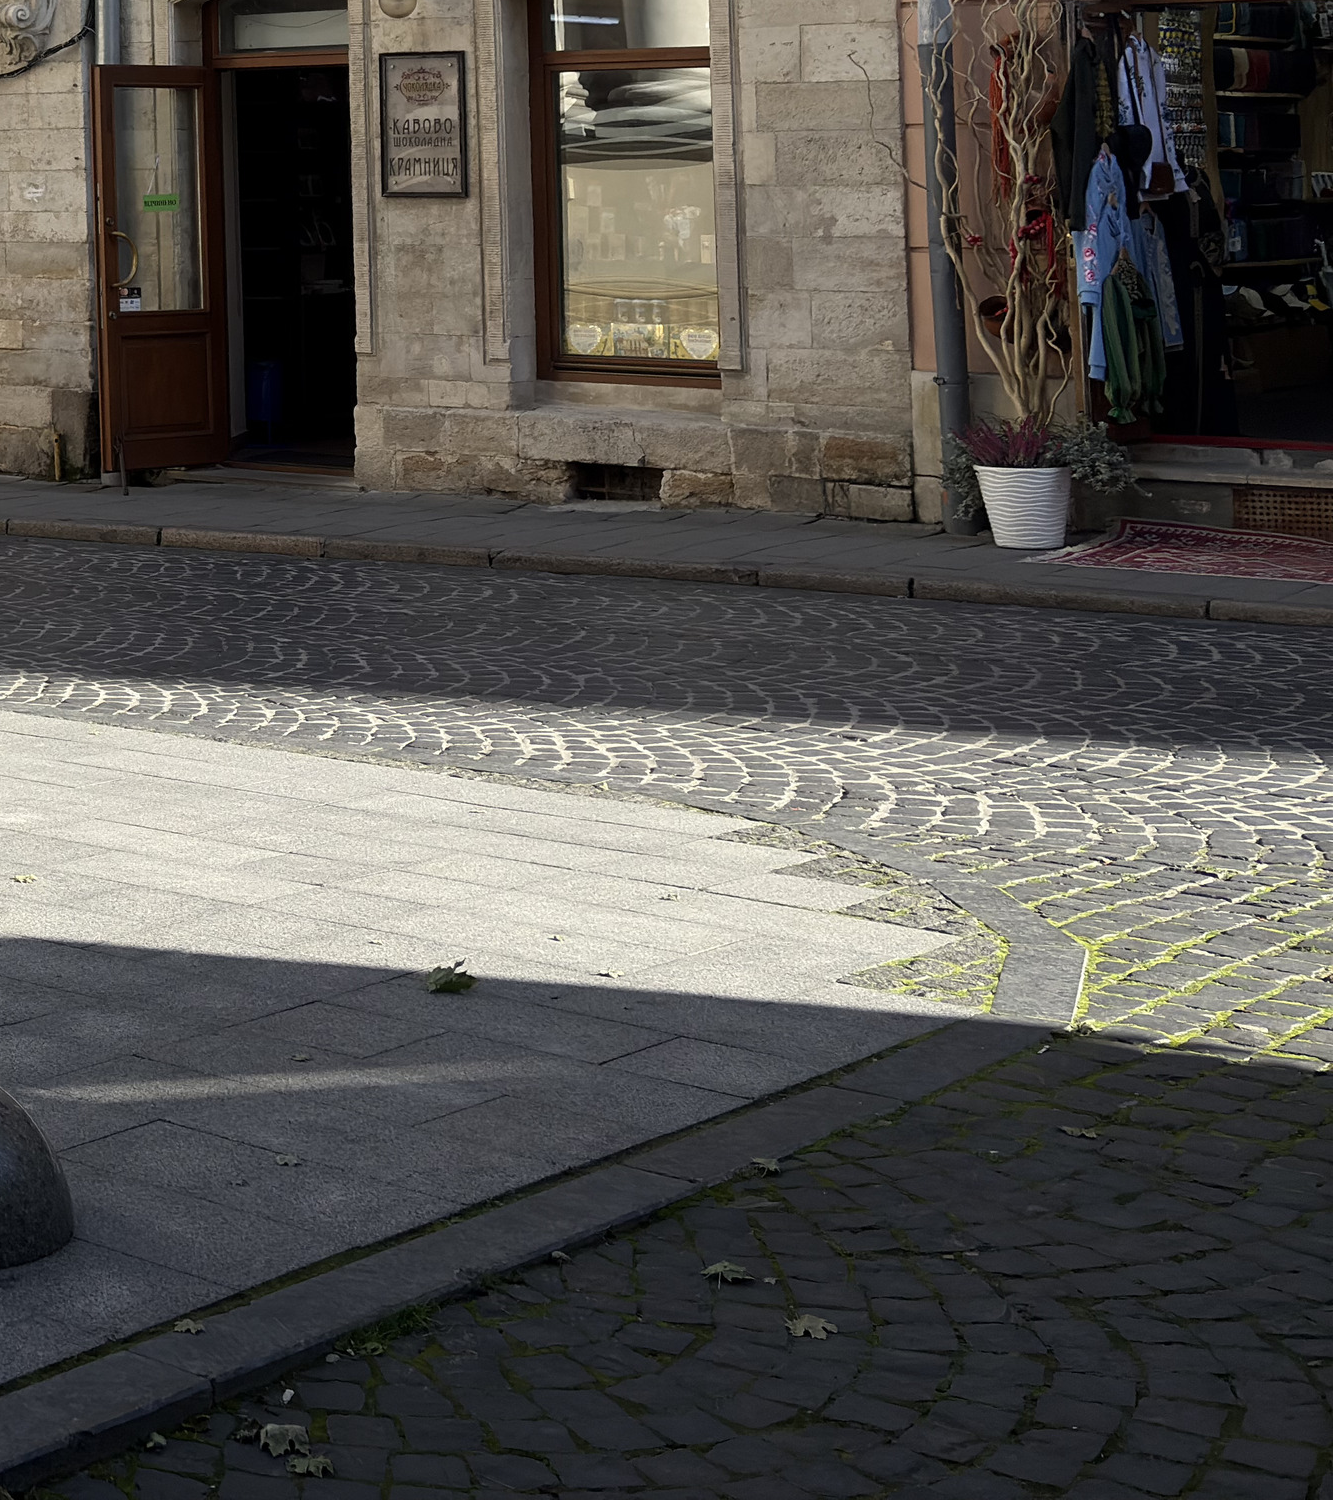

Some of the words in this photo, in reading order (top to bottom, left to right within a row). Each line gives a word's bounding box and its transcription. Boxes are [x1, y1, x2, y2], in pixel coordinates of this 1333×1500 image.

[402, 82, 442, 93] ЧОКОЛЯДКА
[393, 136, 453, 147] ШОКОЛАДНА
[389, 157, 458, 176] КРАМНИЦЯ
